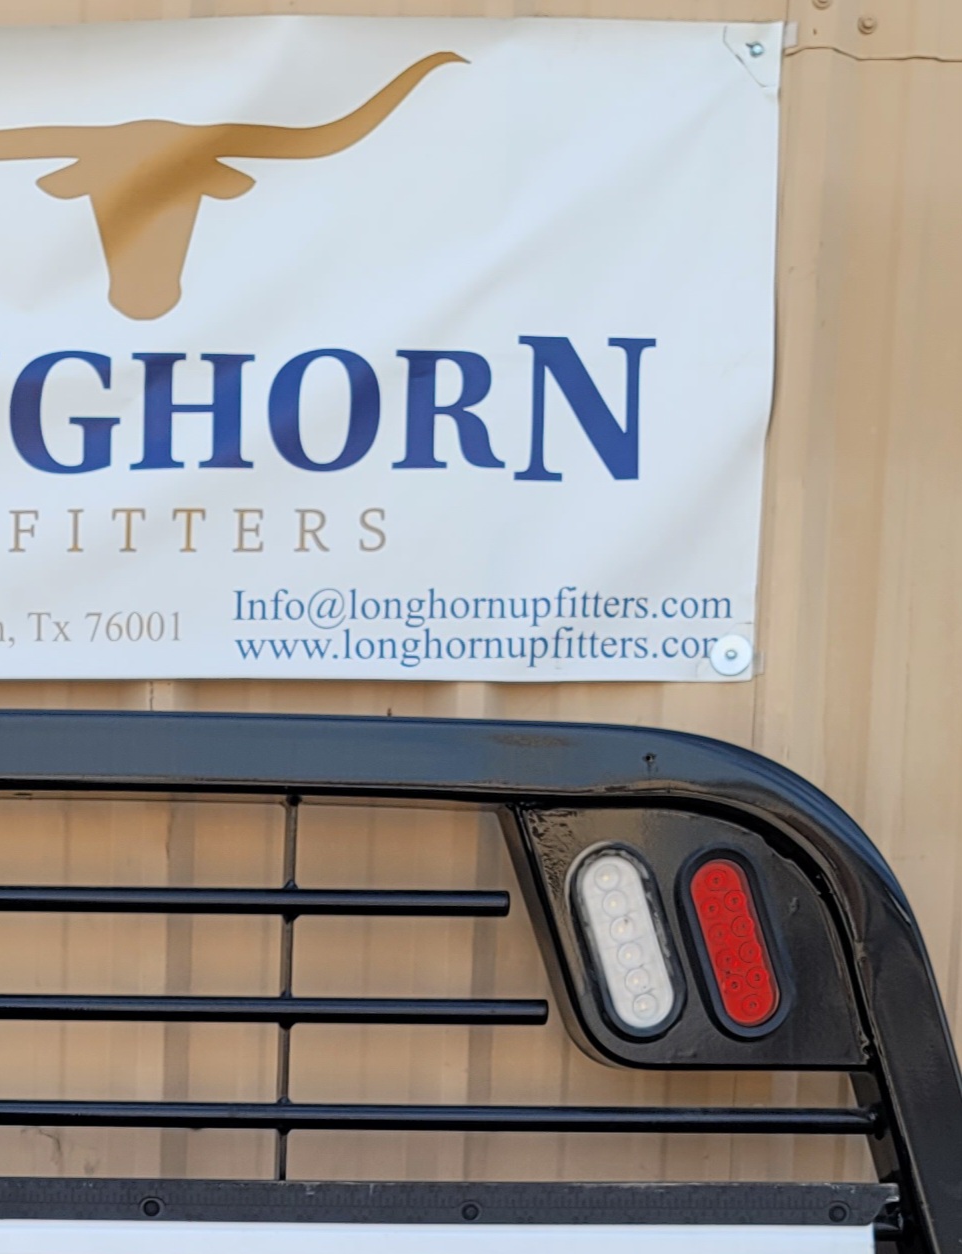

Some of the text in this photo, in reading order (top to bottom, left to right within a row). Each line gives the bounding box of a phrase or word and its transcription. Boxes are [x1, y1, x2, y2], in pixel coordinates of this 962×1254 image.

[27, 611, 71, 642] Tx
[84, 611, 182, 642] 76001
[232, 586, 733, 631] Info@longhornupfitters.com
